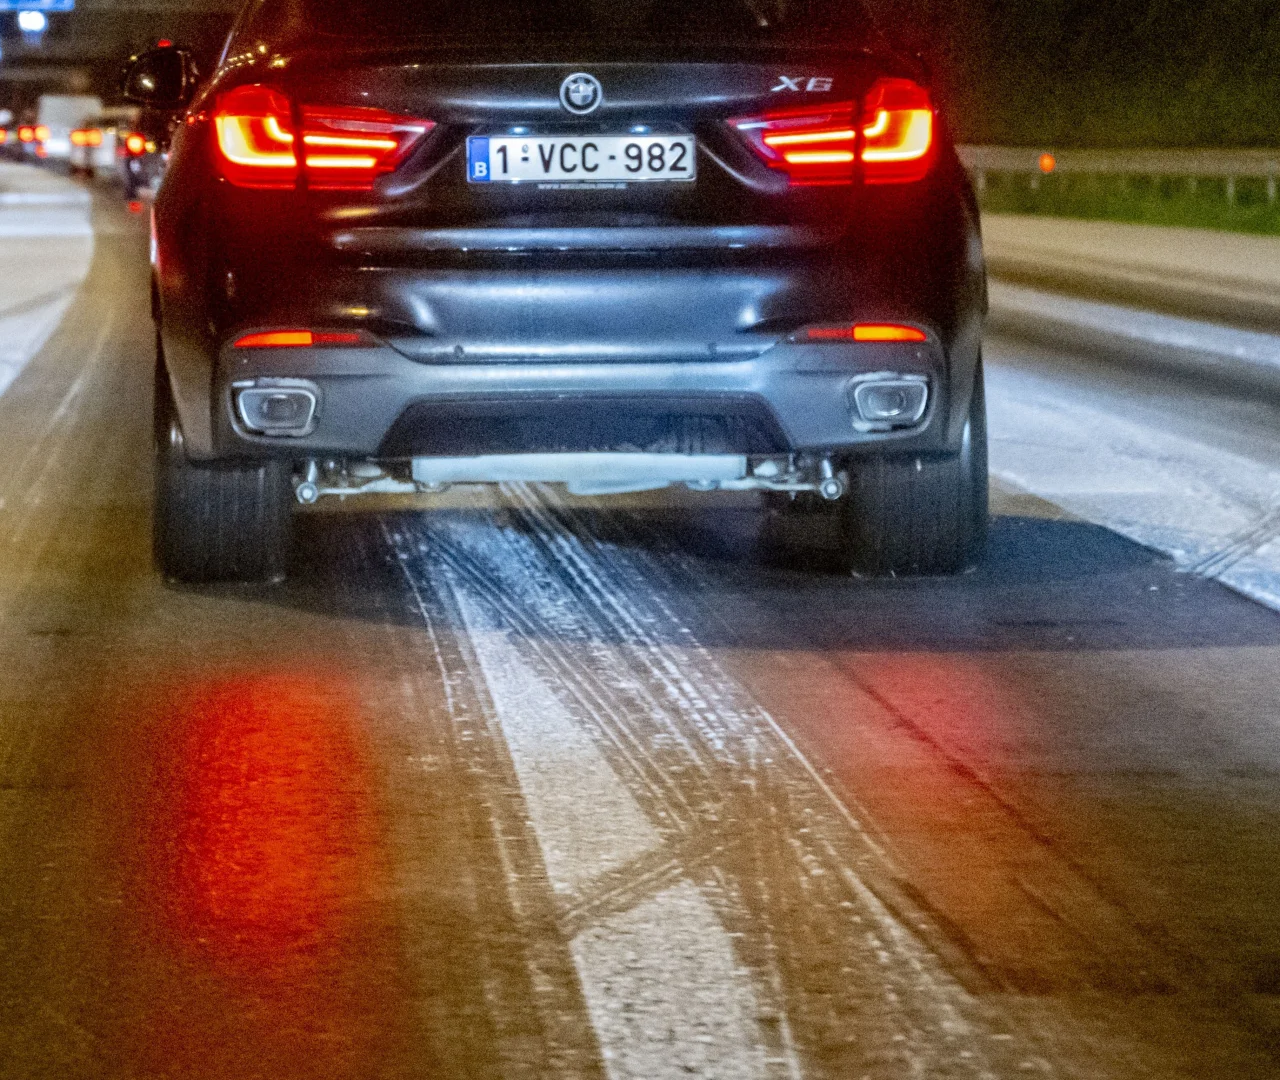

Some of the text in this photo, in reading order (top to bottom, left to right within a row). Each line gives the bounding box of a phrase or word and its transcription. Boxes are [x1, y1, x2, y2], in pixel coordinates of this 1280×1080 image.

[770, 75, 834, 92] X6
[496, 142, 688, 174] 1-VCC-982
[474, 161, 488, 177] B
